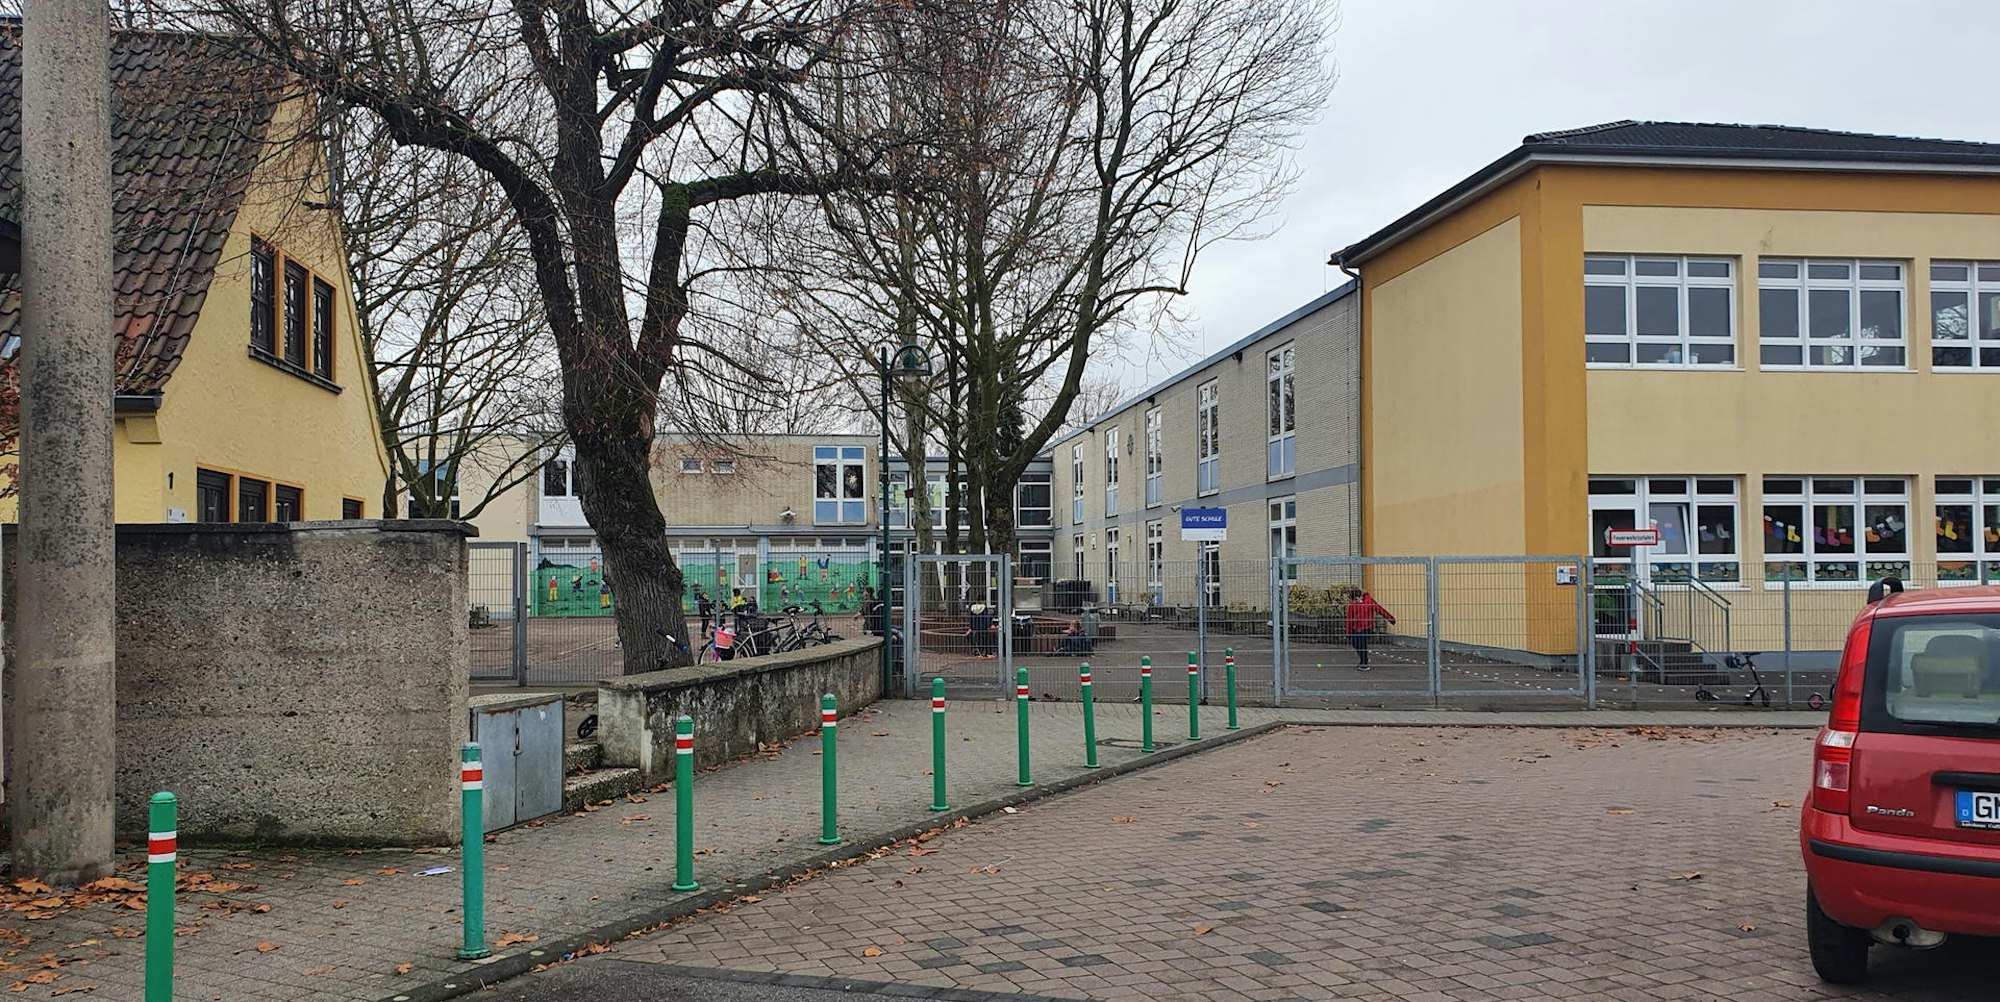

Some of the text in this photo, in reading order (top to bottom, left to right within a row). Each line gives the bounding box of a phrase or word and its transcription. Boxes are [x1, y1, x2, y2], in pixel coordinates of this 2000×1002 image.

[168, 472, 174, 490] 1
[1201, 515, 1222, 523] SCHULE
[1866, 805, 1916, 817] Panda
